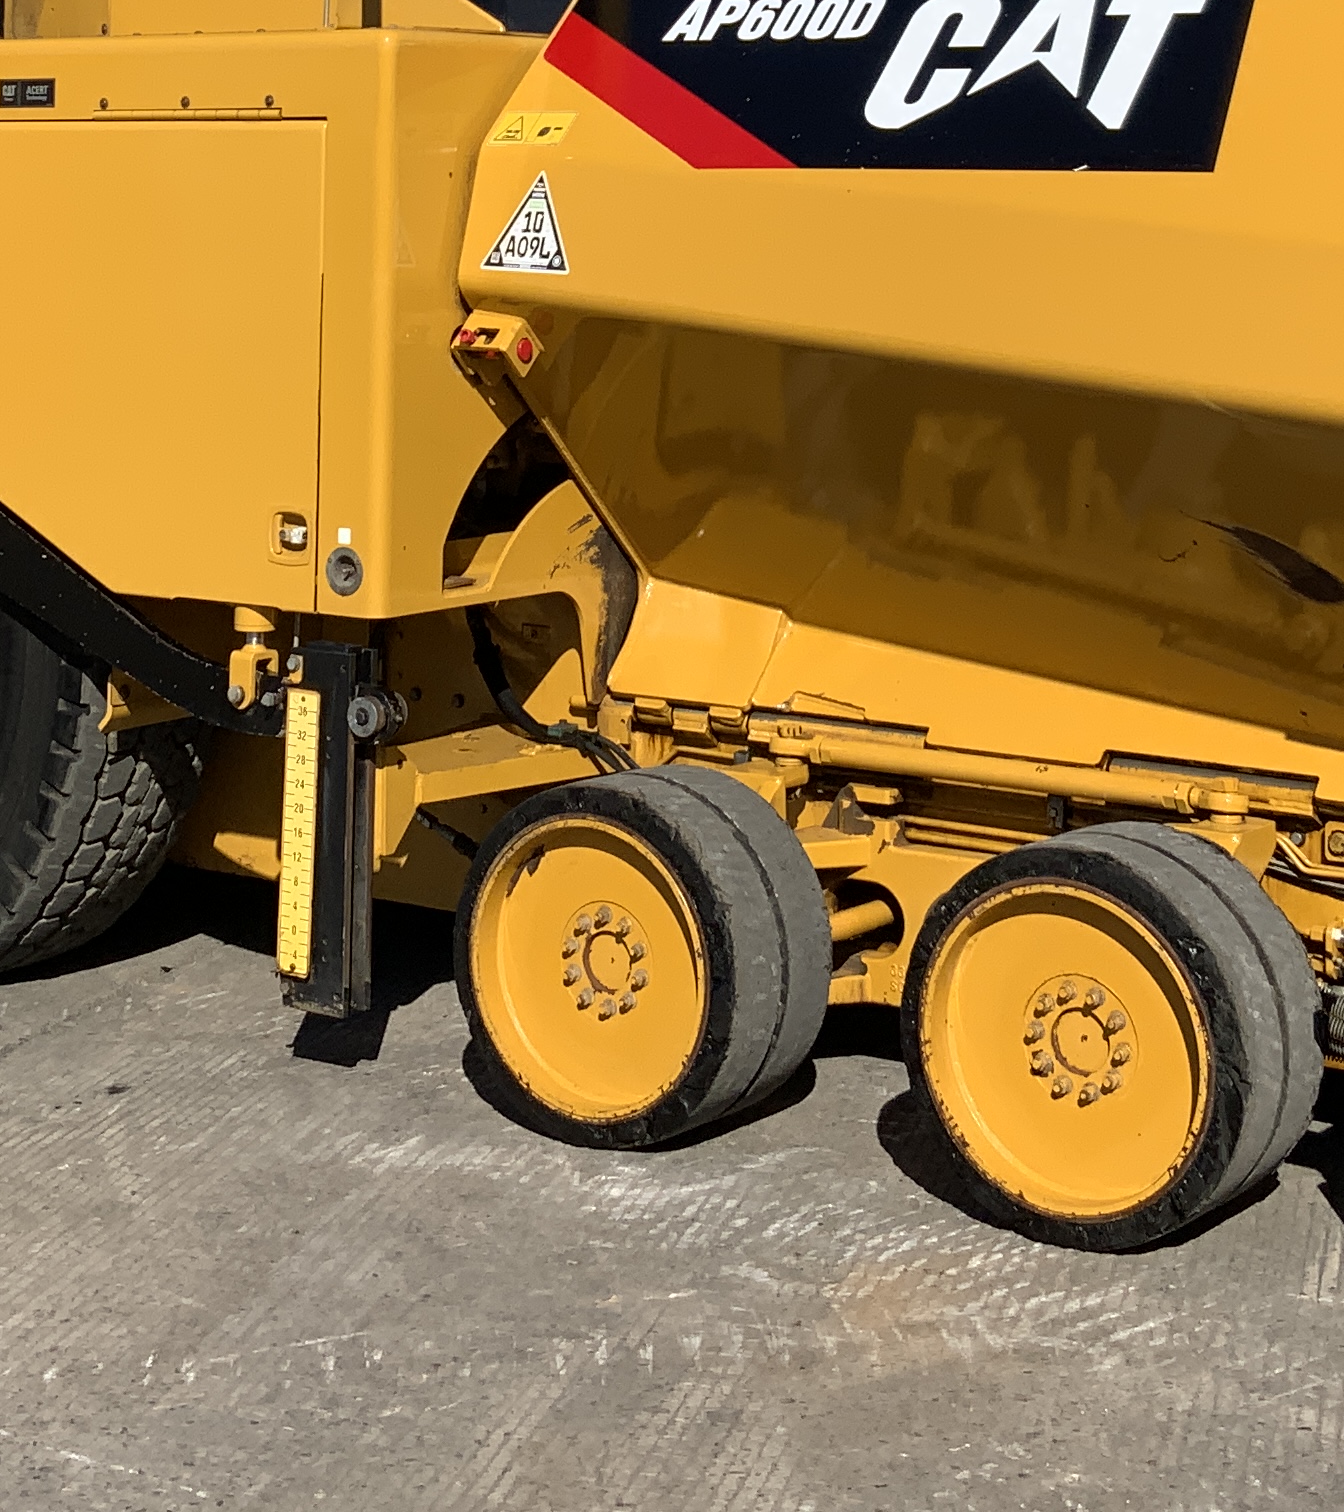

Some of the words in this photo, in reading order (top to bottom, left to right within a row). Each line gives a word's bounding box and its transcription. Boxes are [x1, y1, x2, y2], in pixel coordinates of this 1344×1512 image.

[2, 84, 17, 97] CAT
[296, 730, 307, 741] 32
[295, 754, 306, 765] 28
[295, 778, 305, 790] 24
[294, 802, 304, 814] 20
[293, 827, 303, 838] 16
[292, 851, 302, 863] 12
